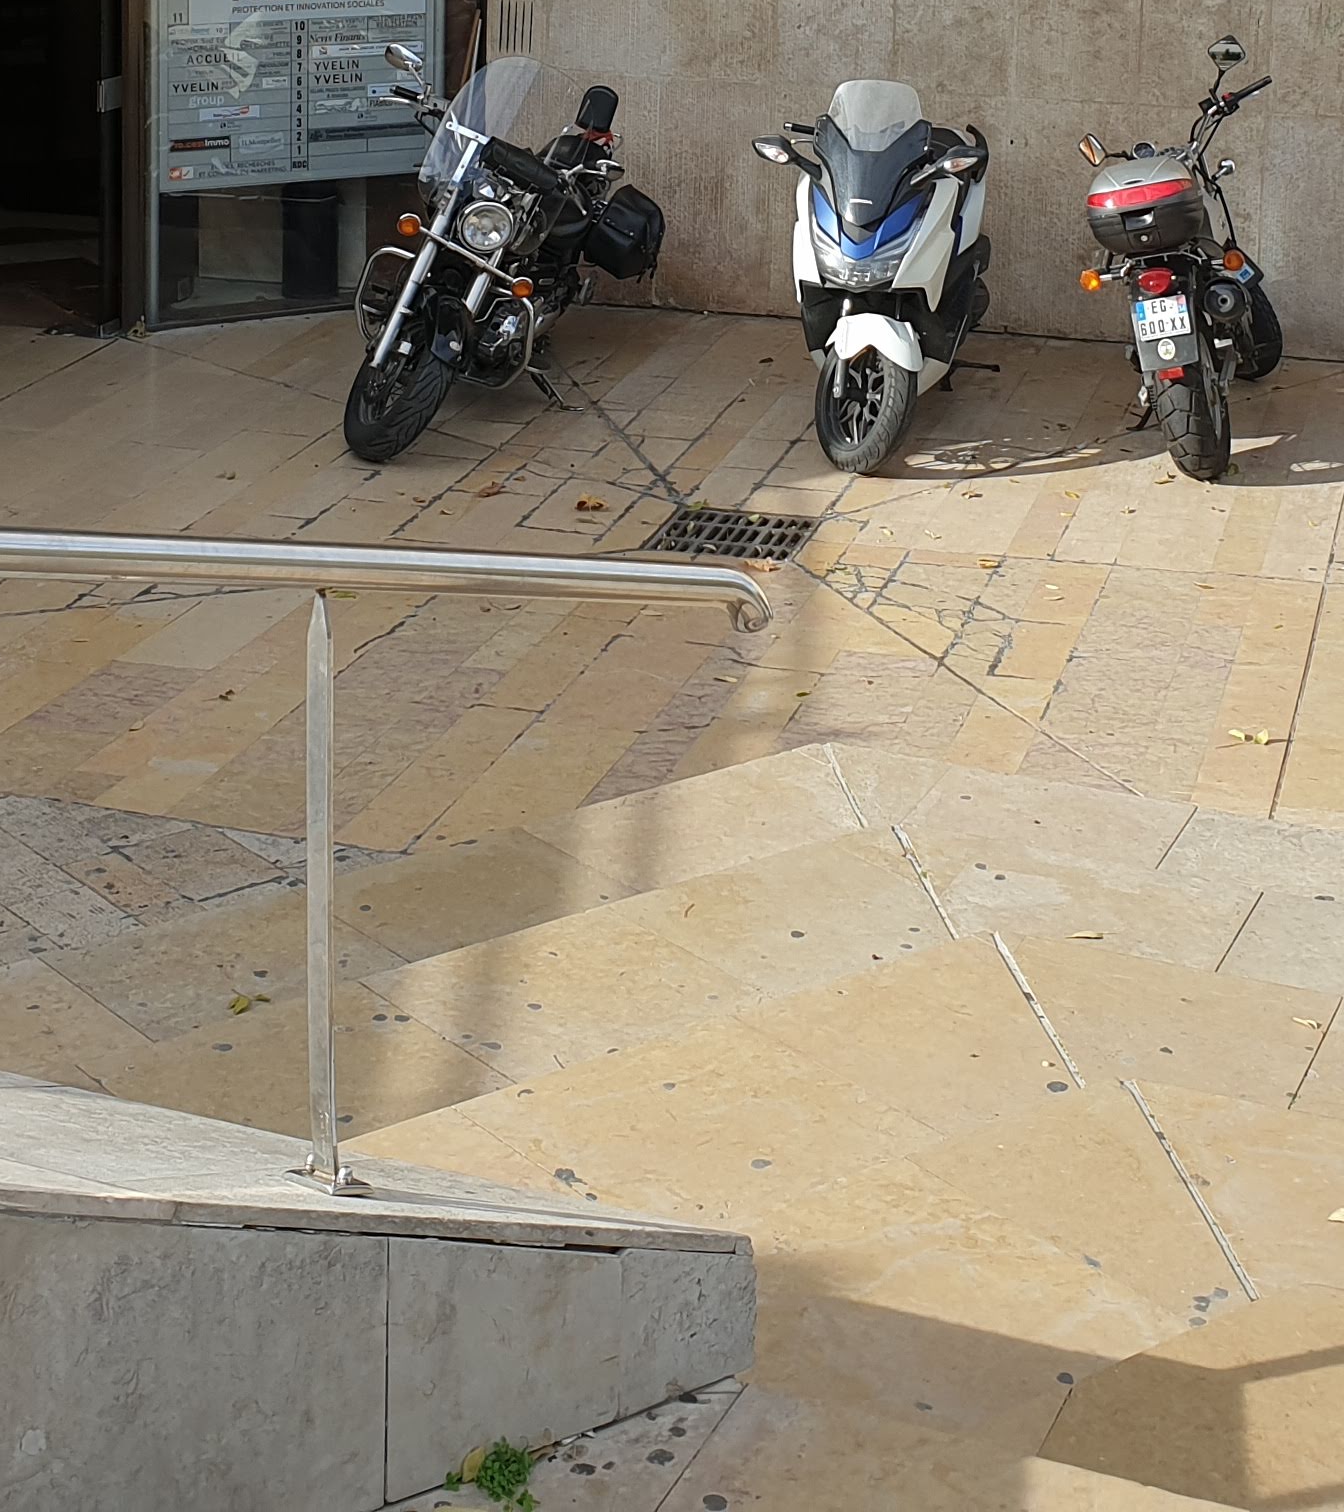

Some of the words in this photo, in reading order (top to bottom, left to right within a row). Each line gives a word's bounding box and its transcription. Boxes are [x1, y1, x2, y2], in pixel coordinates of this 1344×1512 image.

[231, 5, 284, 14] PROTECTION
[285, 3, 295, 12] ET
[297, 1, 346, 11] INNOVATION
[347, 0, 385, 8] SOCIALES
[294, 20, 306, 31] 10
[296, 35, 302, 45] 9
[186, 52, 242, 65] ACCUEIL
[296, 49, 302, 59] 8
[297, 62, 302, 72] 7
[314, 59, 360, 71] YVELIN
[296, 76, 302, 86] 6
[314, 72, 363, 85] YVELIN
[172, 81, 219, 93] YVELIN
[296, 90, 302, 100] 5
[188, 95, 225, 108] group
[296, 104, 302, 114] 4
[296, 118, 302, 128] 3
[296, 132, 302, 141] 2
